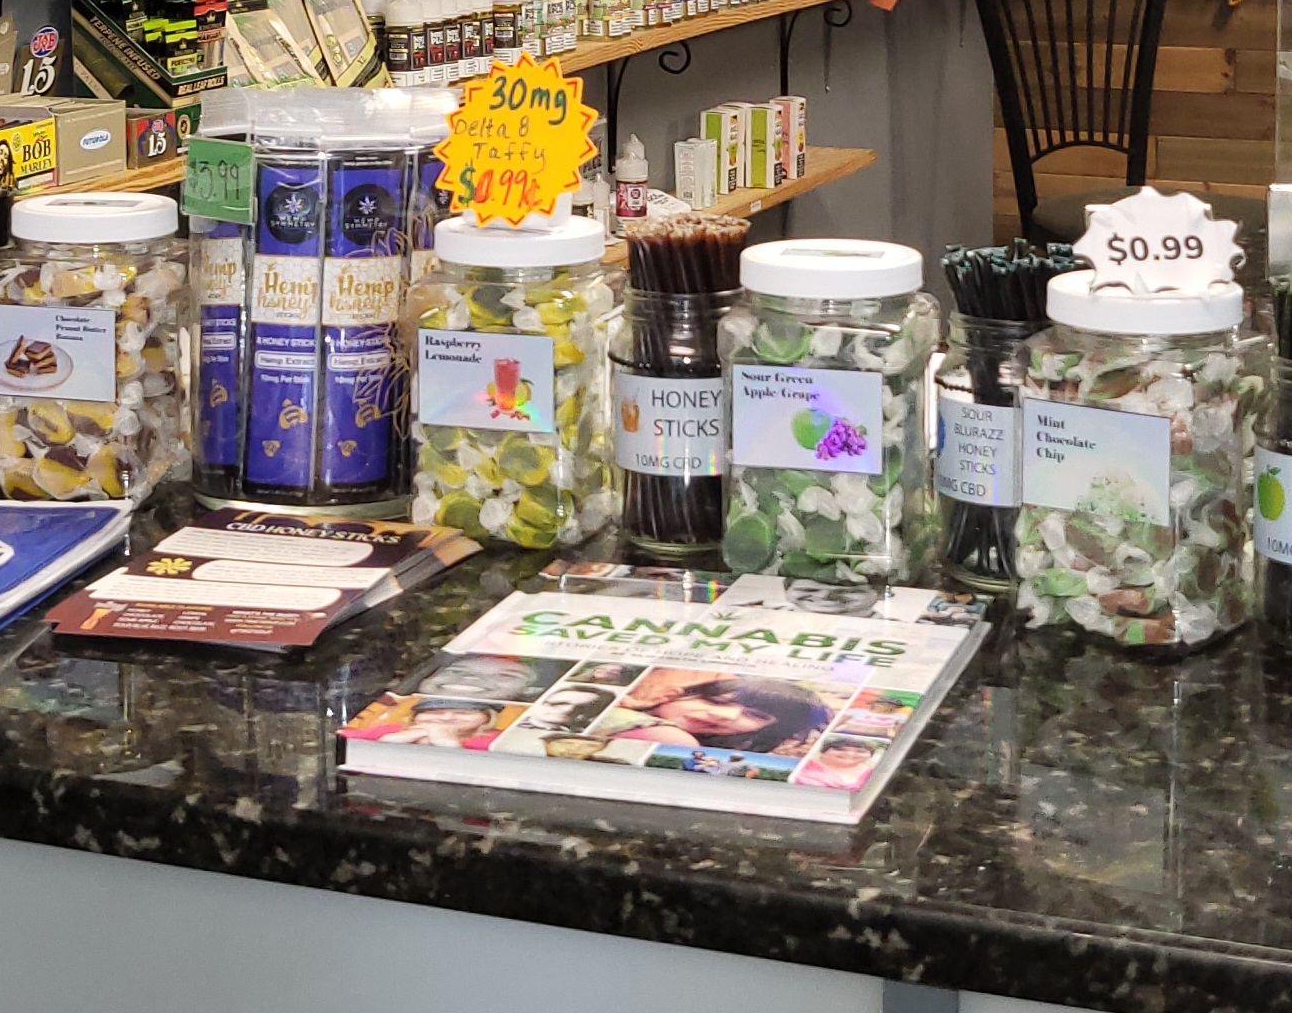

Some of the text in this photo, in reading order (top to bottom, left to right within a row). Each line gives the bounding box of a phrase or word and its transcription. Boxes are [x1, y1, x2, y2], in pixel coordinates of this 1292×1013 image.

[33, 32, 56, 54] JOB
[90, 15, 161, 81] TERPENE INFUSED
[488, 75, 567, 126] 30mg
[454, 115, 530, 139] Delta 8
[22, 138, 52, 162] BOB
[472, 141, 548, 176] Taffy
[20, 158, 54, 174] MARLEY
[1107, 230, 1205, 267] $0.99
[424, 334, 482, 350] Raspberry
[424, 350, 483, 365] Lemonade
[740, 370, 814, 386] Sour Green
[651, 388, 723, 409] HONEY
[743, 386, 821, 403] Apple Grape
[960, 406, 994, 422] SOUR
[1037, 413, 1066, 430] Mint
[653, 418, 721, 438] STICKS
[953, 423, 1005, 441] BLURAZZ
[1036, 431, 1098, 451] Chocolate
[958, 443, 998, 459] HONEY
[1036, 446, 1066, 464] Chip
[635, 452, 703, 470] 10MG CBD
[959, 459, 997, 476] STICKS
[960, 480, 987, 498] CBD
[225, 521, 402, 546] CBD HONEY STICKS
[521, 610, 907, 657] CANNABIS
[509, 625, 899, 669] SAVED MY LIFE
